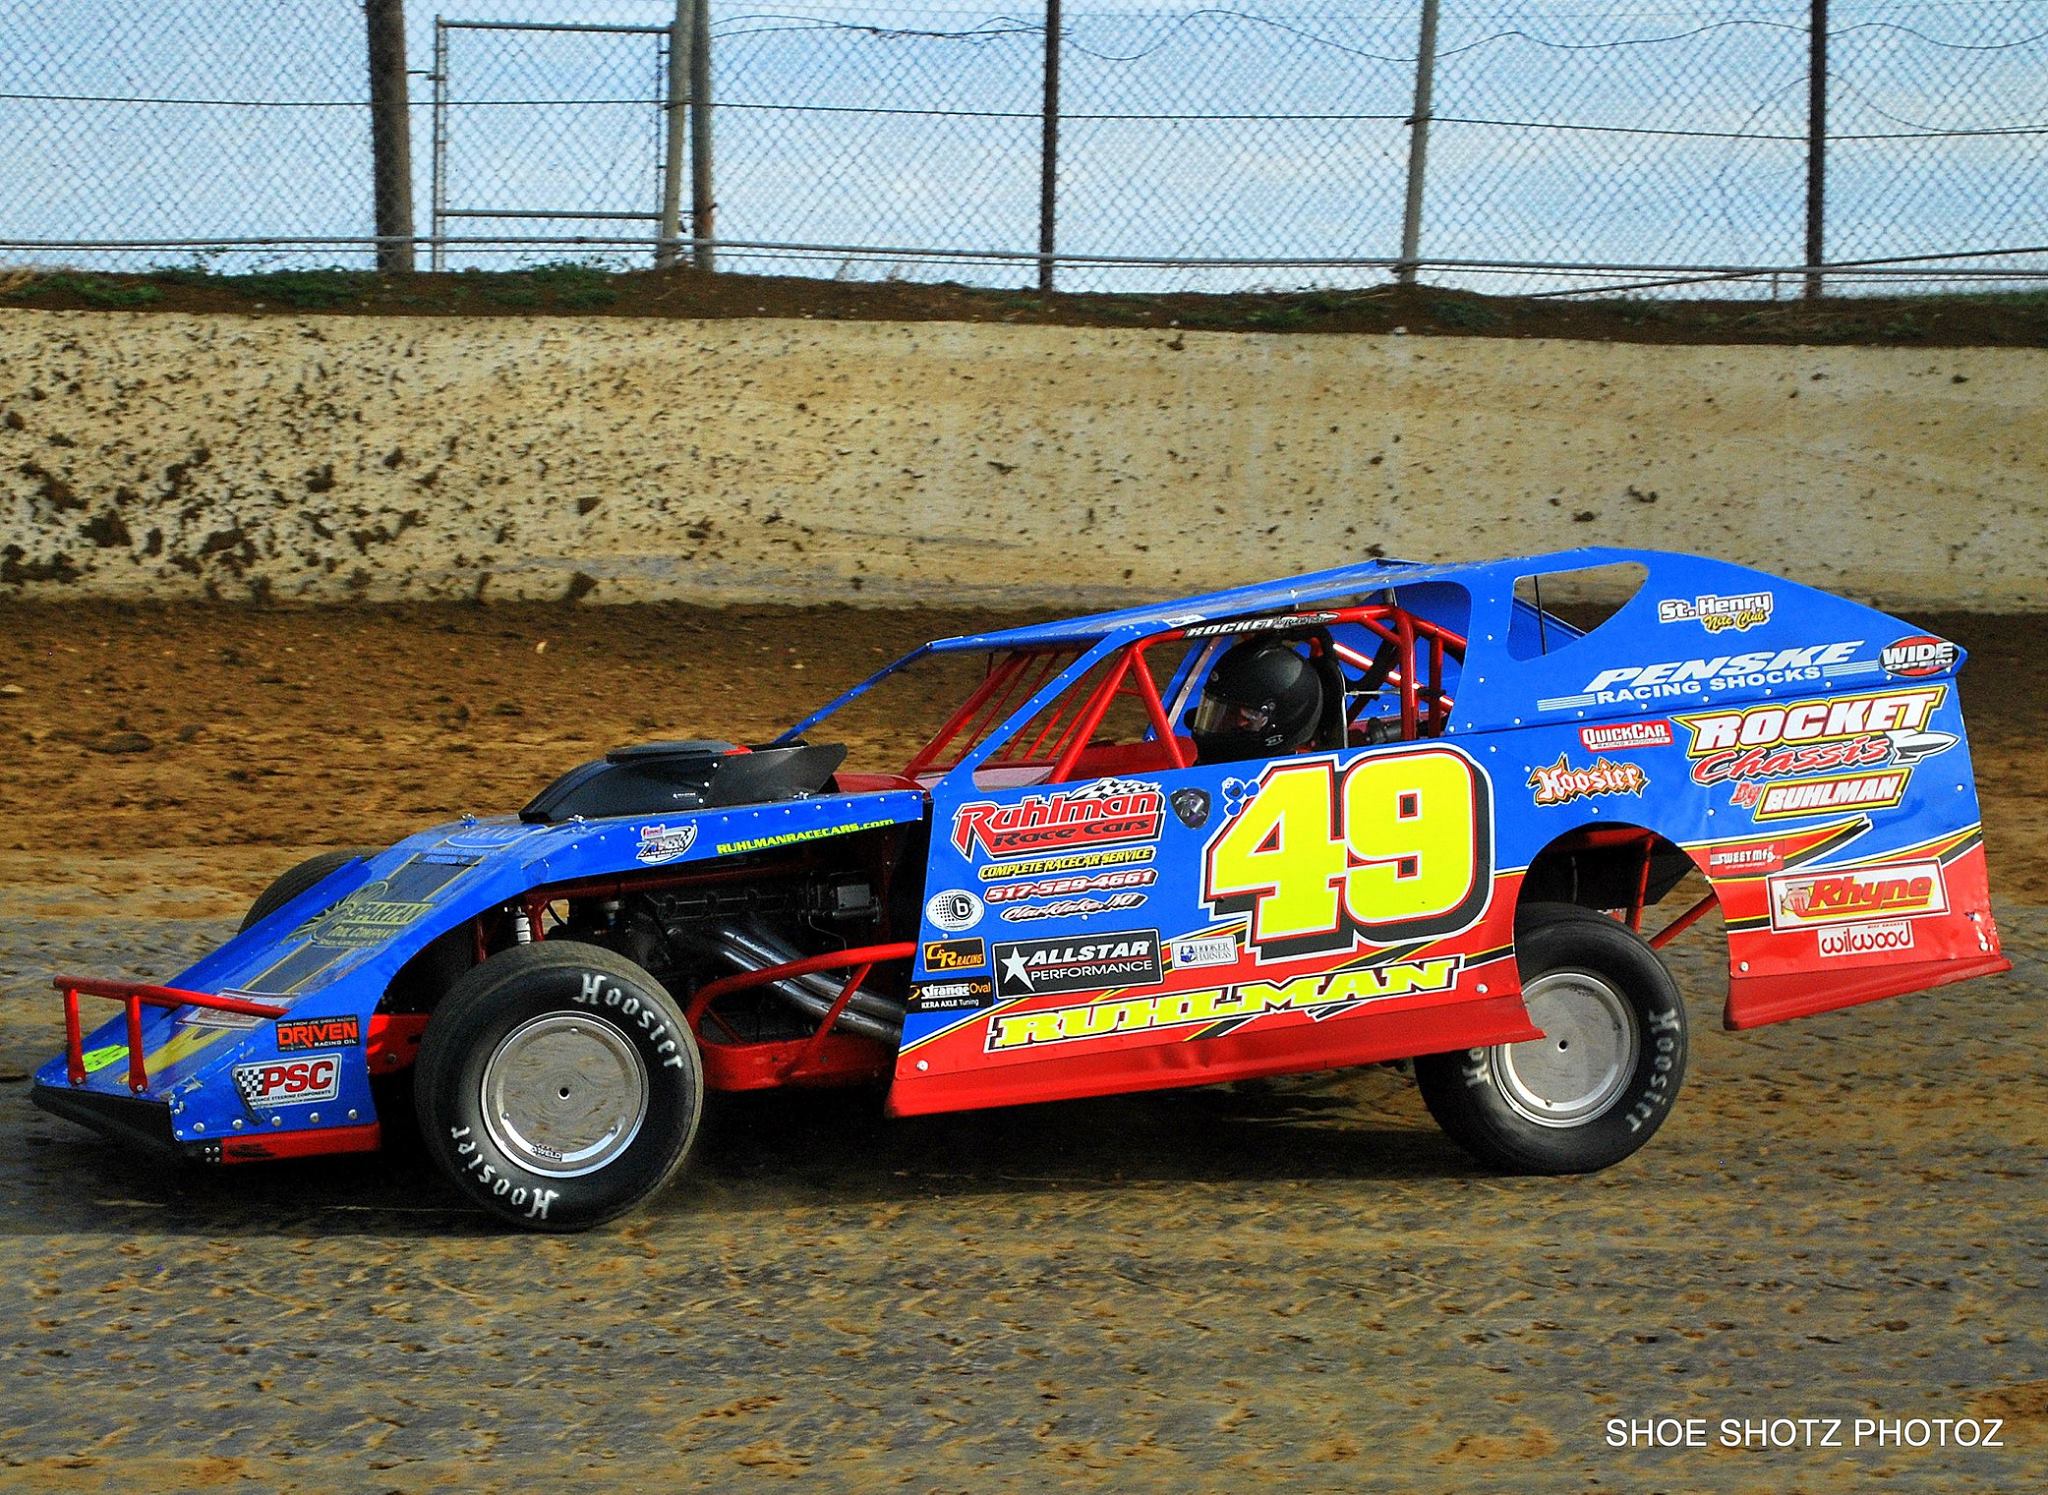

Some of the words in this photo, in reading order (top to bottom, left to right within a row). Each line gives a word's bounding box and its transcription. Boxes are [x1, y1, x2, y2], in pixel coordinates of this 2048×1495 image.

[1660, 601, 1697, 620] St.
[1699, 592, 1771, 622] Henry
[1704, 612, 1735, 631] Nite
[1737, 609, 1767, 629] Club
[1186, 618, 1274, 637] ROCKET
[1583, 640, 1867, 693] PENSKE
[1882, 641, 1955, 666] WIDE
[1597, 681, 1702, 705] RACING
[1709, 666, 1822, 692] SHOCKS
[1690, 692, 1939, 752] ROCKET
[1692, 736, 1891, 784] Chassis
[1533, 763, 1644, 803] Hoosier
[1731, 781, 1764, 808] By
[717, 818, 895, 855] RUHLMANRACECARS.com
[954, 790, 1160, 853] Ruhlman
[992, 828, 1074, 847] Race
[1083, 818, 1150, 837] Cars
[979, 862, 1044, 879] COMPLETE
[1043, 854, 1101, 874] RACECAR
[1100, 847, 1152, 865] SERVICE
[1205, 749, 1480, 945] 49
[985, 869, 1156, 903] 517-529-4661
[1806, 876, 1934, 911] Rhyne
[1026, 940, 1151, 966] ALLSTAR
[1821, 921, 1912, 954] wilwood
[926, 944, 958, 968] C&R
[955, 953, 983, 966] RACING
[1030, 959, 1153, 982] PERFORMANCE
[921, 983, 970, 998] Strange
[969, 982, 992, 994] Oval
[992, 956, 1460, 1048] RUHLMAN
[277, 1021, 358, 1048] DRIVEN
[572, 973, 684, 1069] Hoosier
[260, 1060, 334, 1096] PSC
[1625, 1006, 1681, 1132] Hoosier
[451, 1125, 560, 1220] Hoosier
